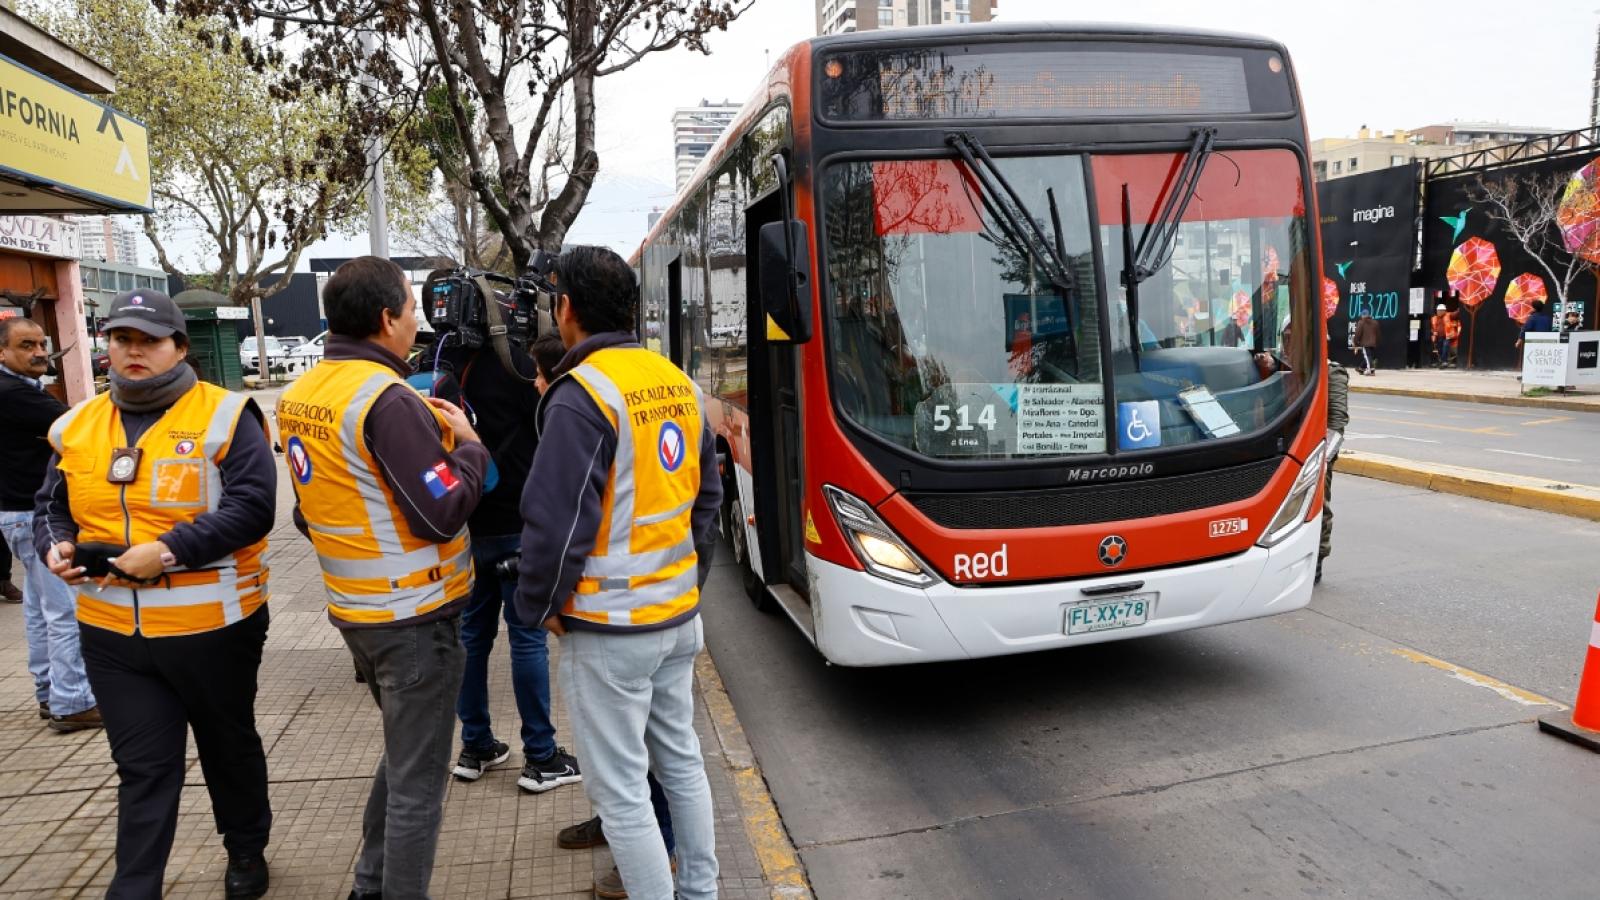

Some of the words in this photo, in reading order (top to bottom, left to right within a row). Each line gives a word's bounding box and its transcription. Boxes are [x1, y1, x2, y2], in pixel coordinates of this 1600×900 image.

[1353, 204, 1394, 223] imagina
[0, 236, 17, 246] ON
[20, 239, 35, 250] DE
[1031, 397, 1065, 405] Salvador
[1071, 397, 1105, 405] Alameda
[934, 404, 997, 431] 514
[1022, 408, 1060, 416] Miraflores
[1067, 419, 1099, 428] Catedral
[1022, 431, 1053, 439] Portales
[1072, 431, 1105, 440] Imperial
[1067, 463, 1154, 481] Marcopolo
[1212, 520, 1238, 536] 1275
[954, 543, 1008, 580] Red
